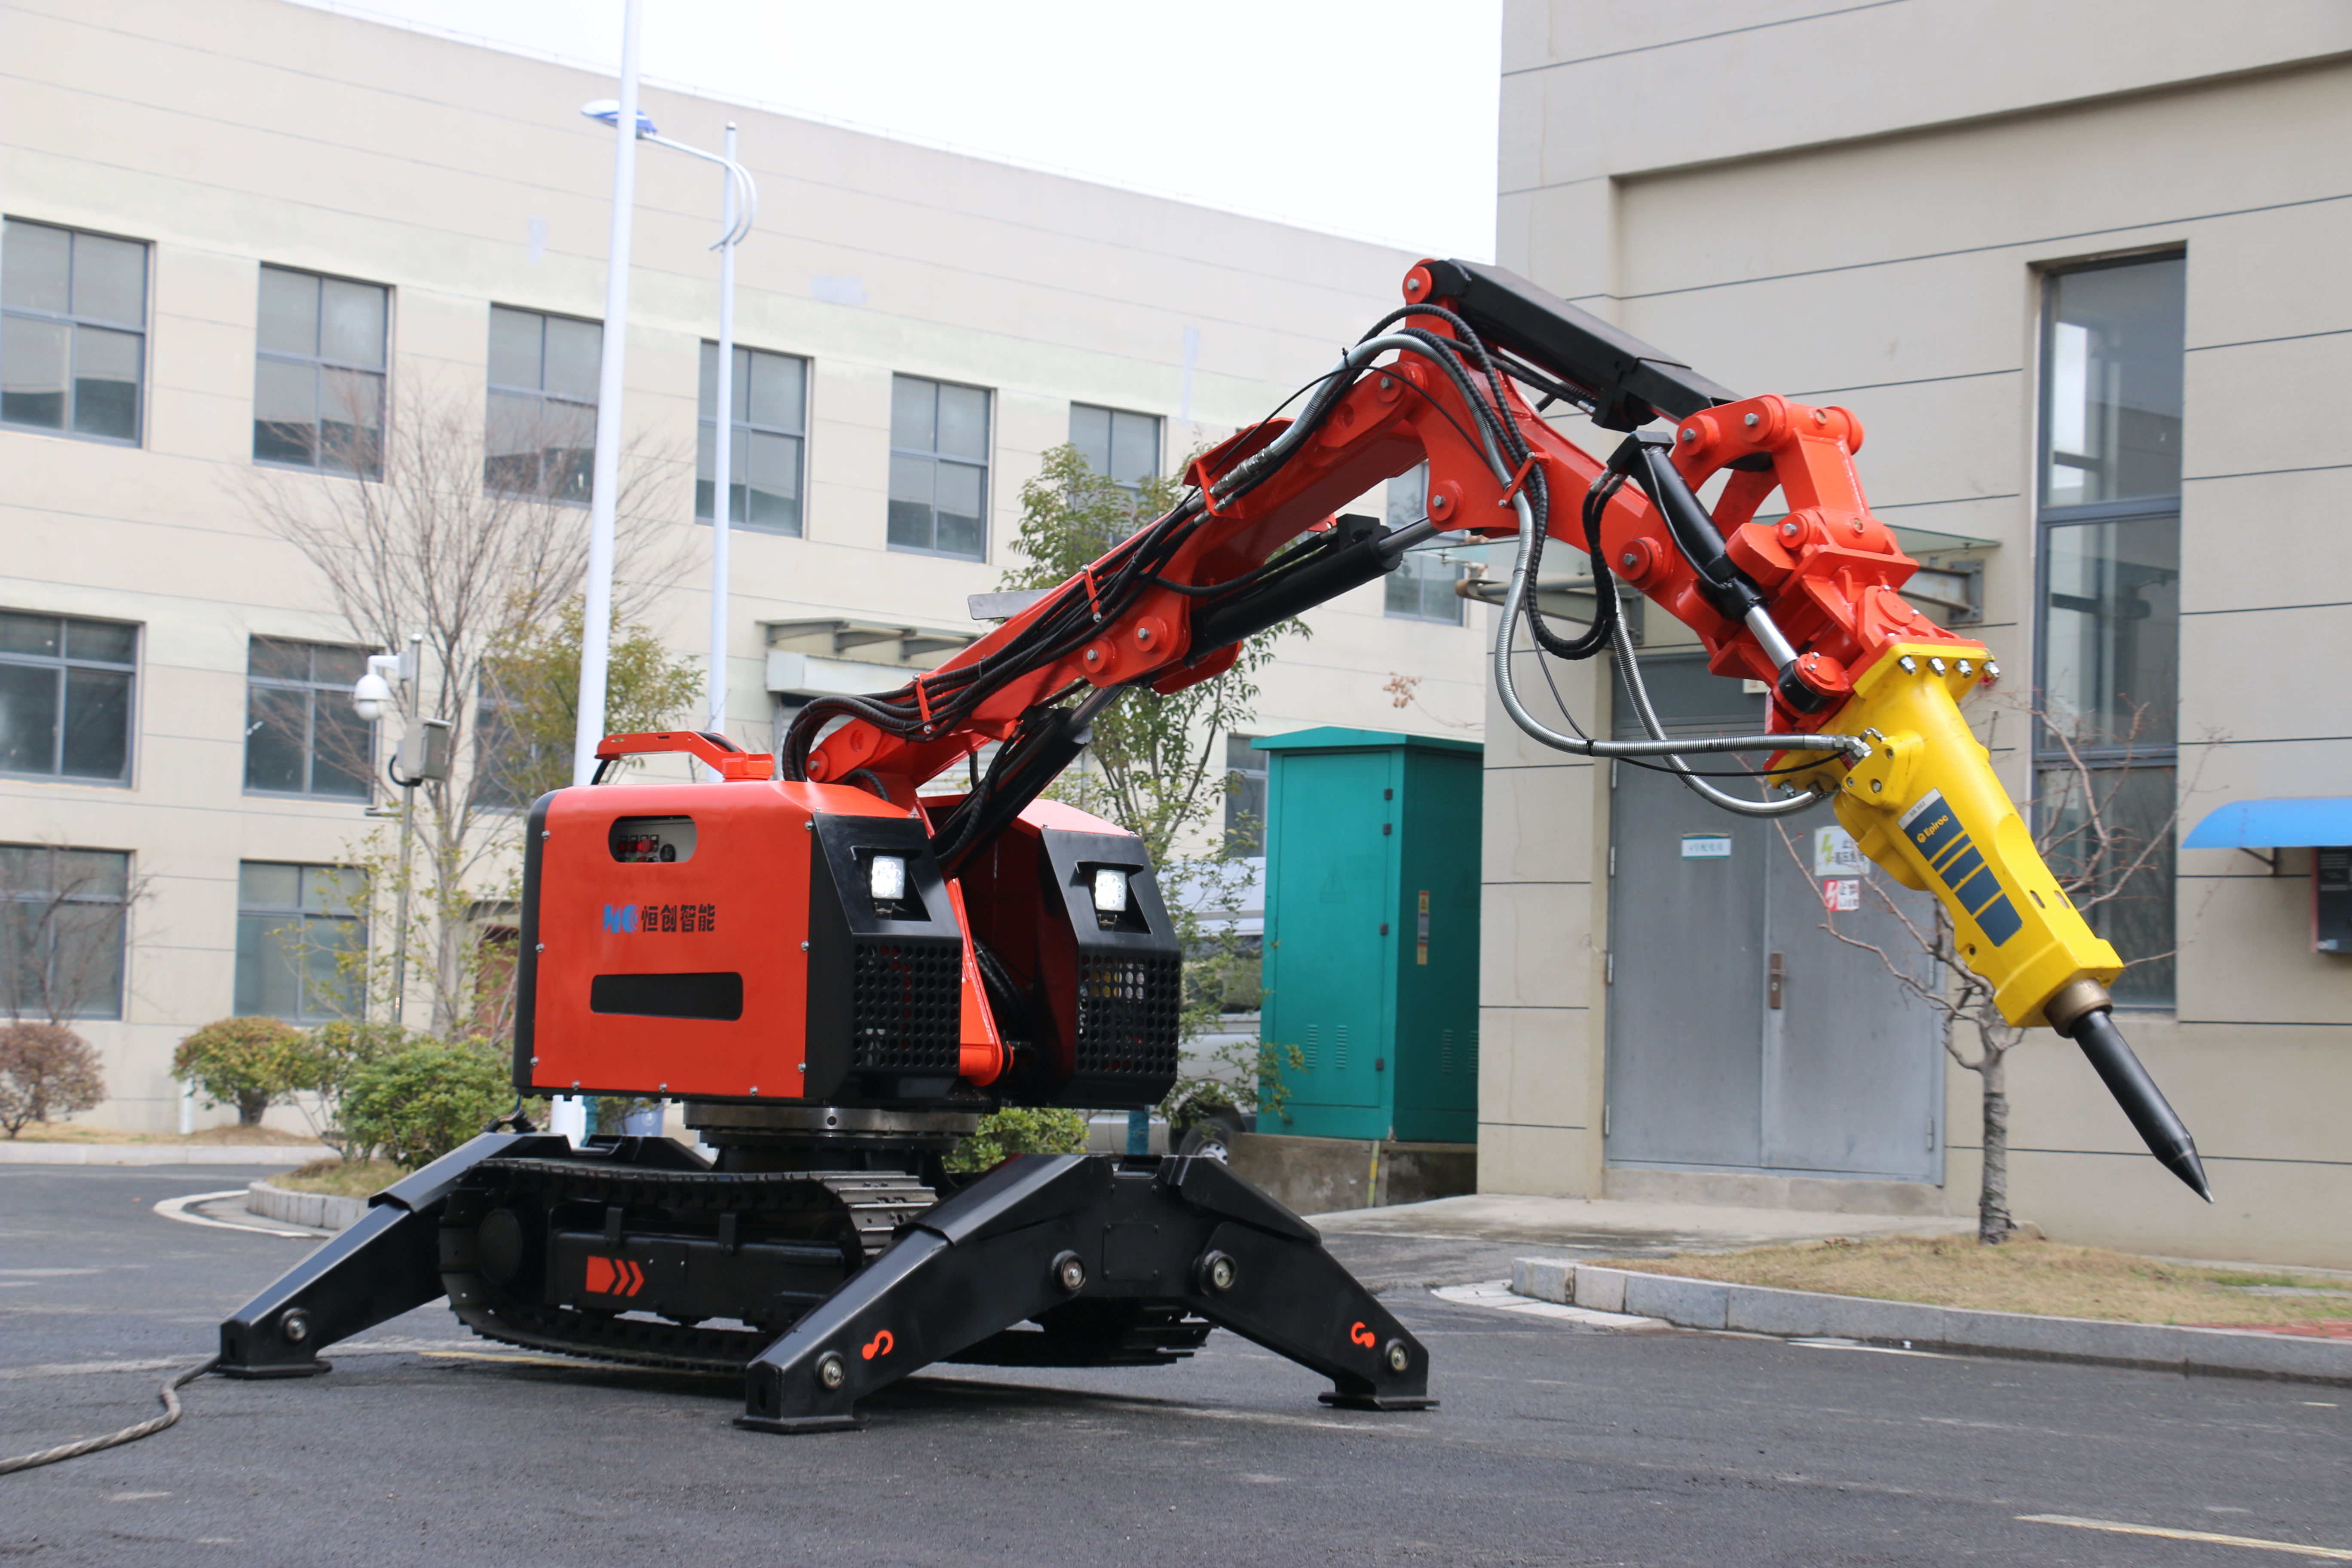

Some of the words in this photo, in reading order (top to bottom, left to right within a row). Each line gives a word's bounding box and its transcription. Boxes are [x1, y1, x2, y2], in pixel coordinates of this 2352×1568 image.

[1917, 801, 1927, 811] 302
[1923, 815, 1949, 837] Epiroc
[641, 903, 716, 932] 恒创智能
